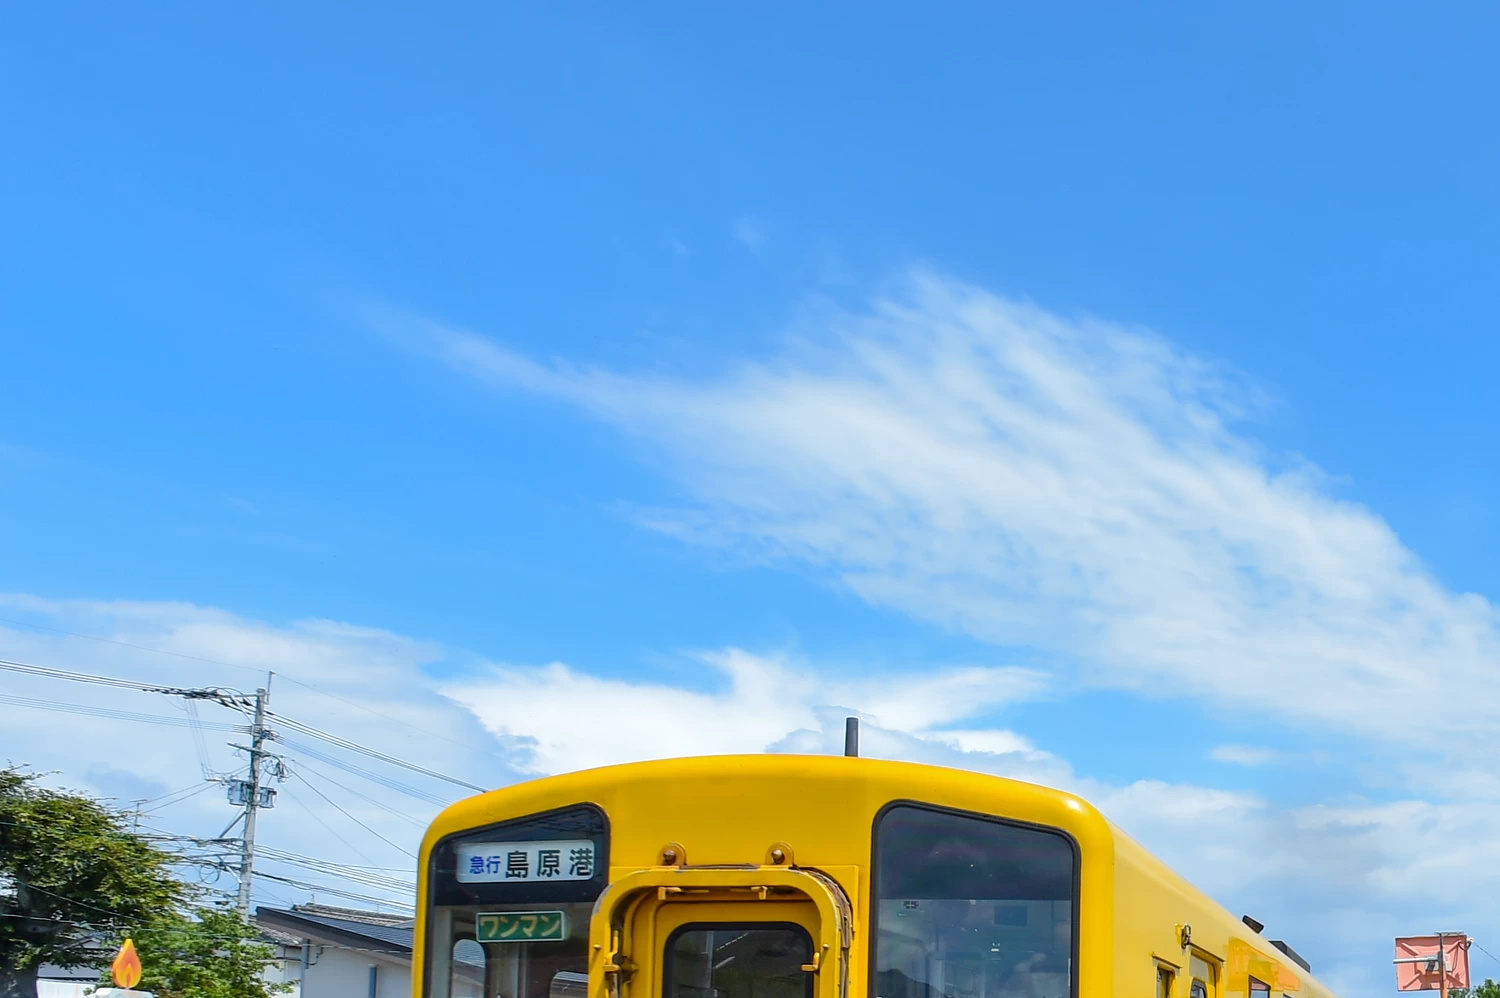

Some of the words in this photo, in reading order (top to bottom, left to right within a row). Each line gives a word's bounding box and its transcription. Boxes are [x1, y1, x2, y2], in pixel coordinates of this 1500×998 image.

[469, 855, 502, 875] 急行
[505, 847, 594, 879] 島原港
[480, 915, 562, 938] ワンマン
